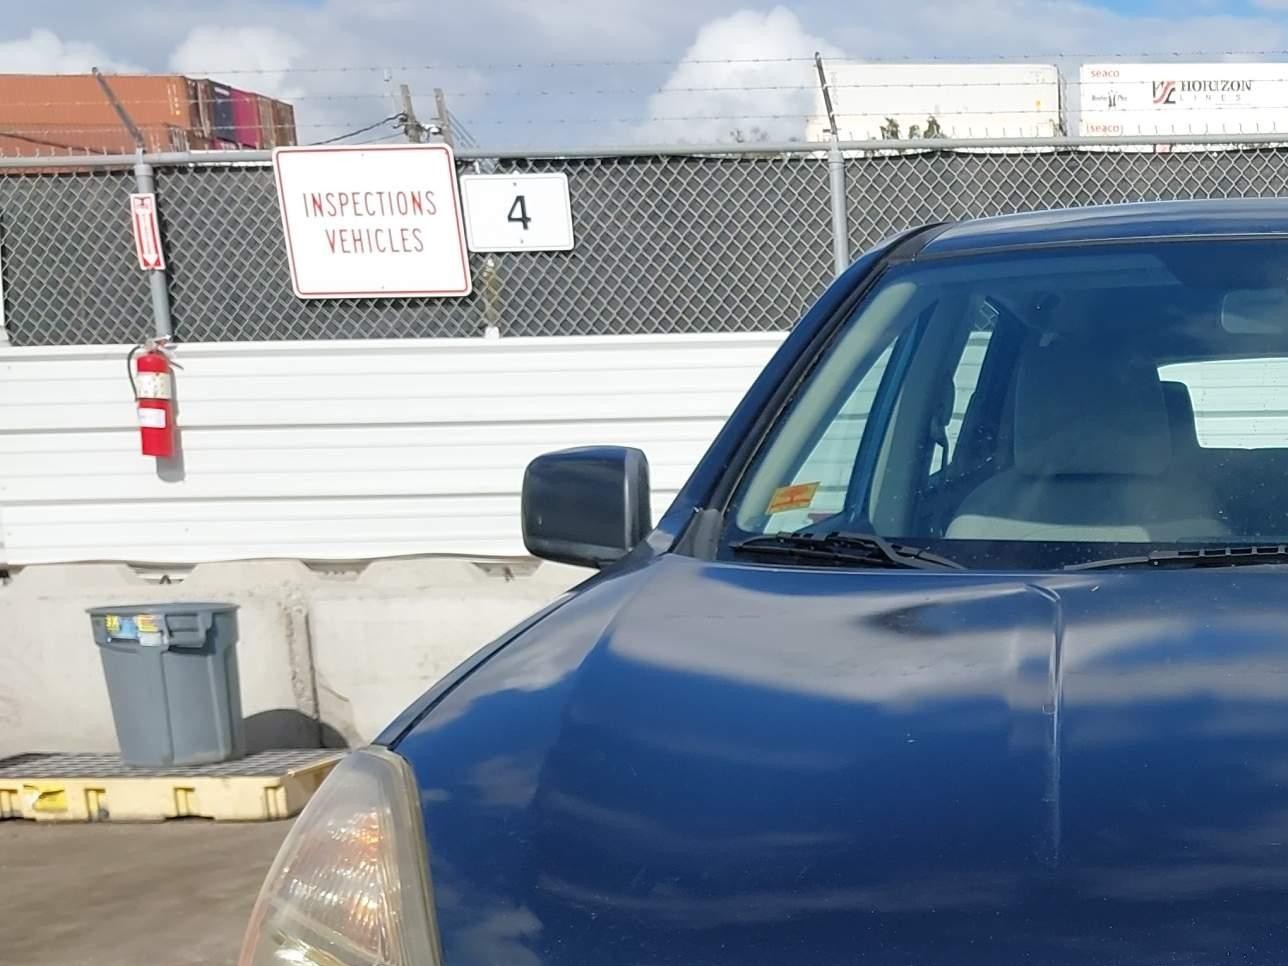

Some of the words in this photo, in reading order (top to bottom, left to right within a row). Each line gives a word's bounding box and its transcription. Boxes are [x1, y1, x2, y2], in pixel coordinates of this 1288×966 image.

[1090, 69, 1120, 78] seaco
[1180, 80, 1252, 92] HORIZON
[303, 191, 437, 217] INSPECTIONS
[507, 195, 532, 230] 4
[325, 228, 424, 254] VEHICLES
